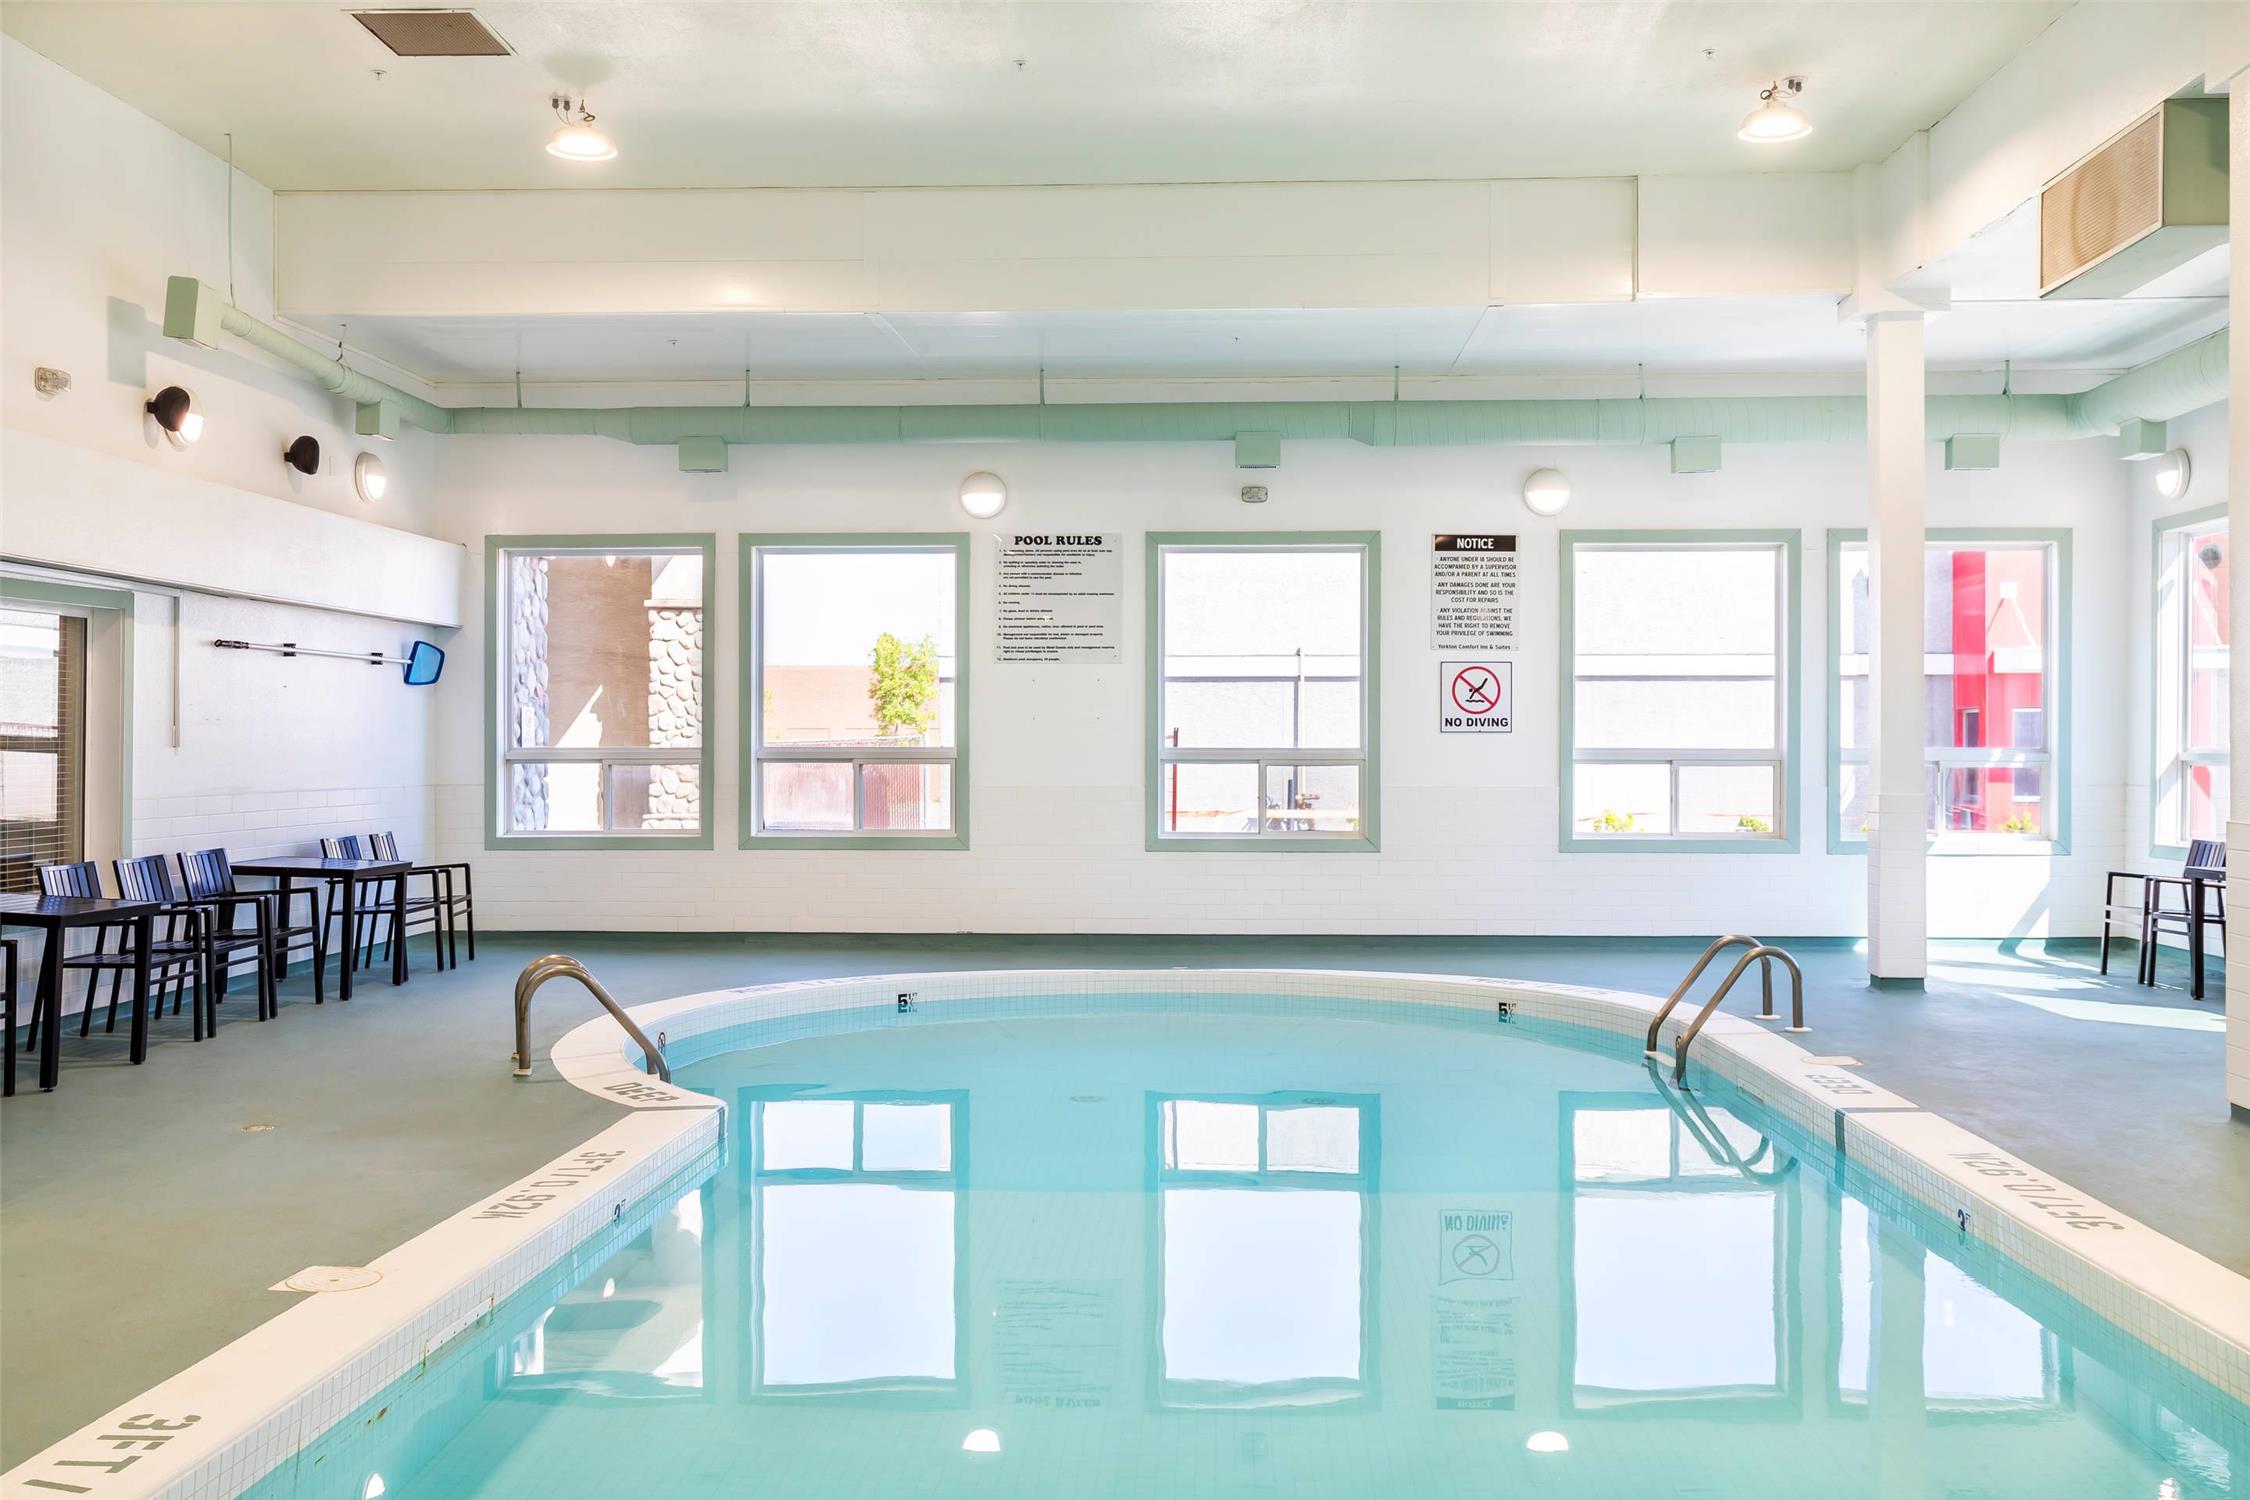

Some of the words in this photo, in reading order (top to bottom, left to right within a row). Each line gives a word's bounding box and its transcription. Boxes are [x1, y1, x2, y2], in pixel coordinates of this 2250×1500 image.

[1014, 535, 1052, 546] POOL
[1056, 535, 1103, 546] RULES
[1456, 538, 1495, 549] NOTICE
[1444, 718, 1462, 727] NO
[1466, 718, 1509, 727] DIVING
[1804, 1074, 1873, 1095] DEEP
[602, 1082, 681, 1102] DEEP
